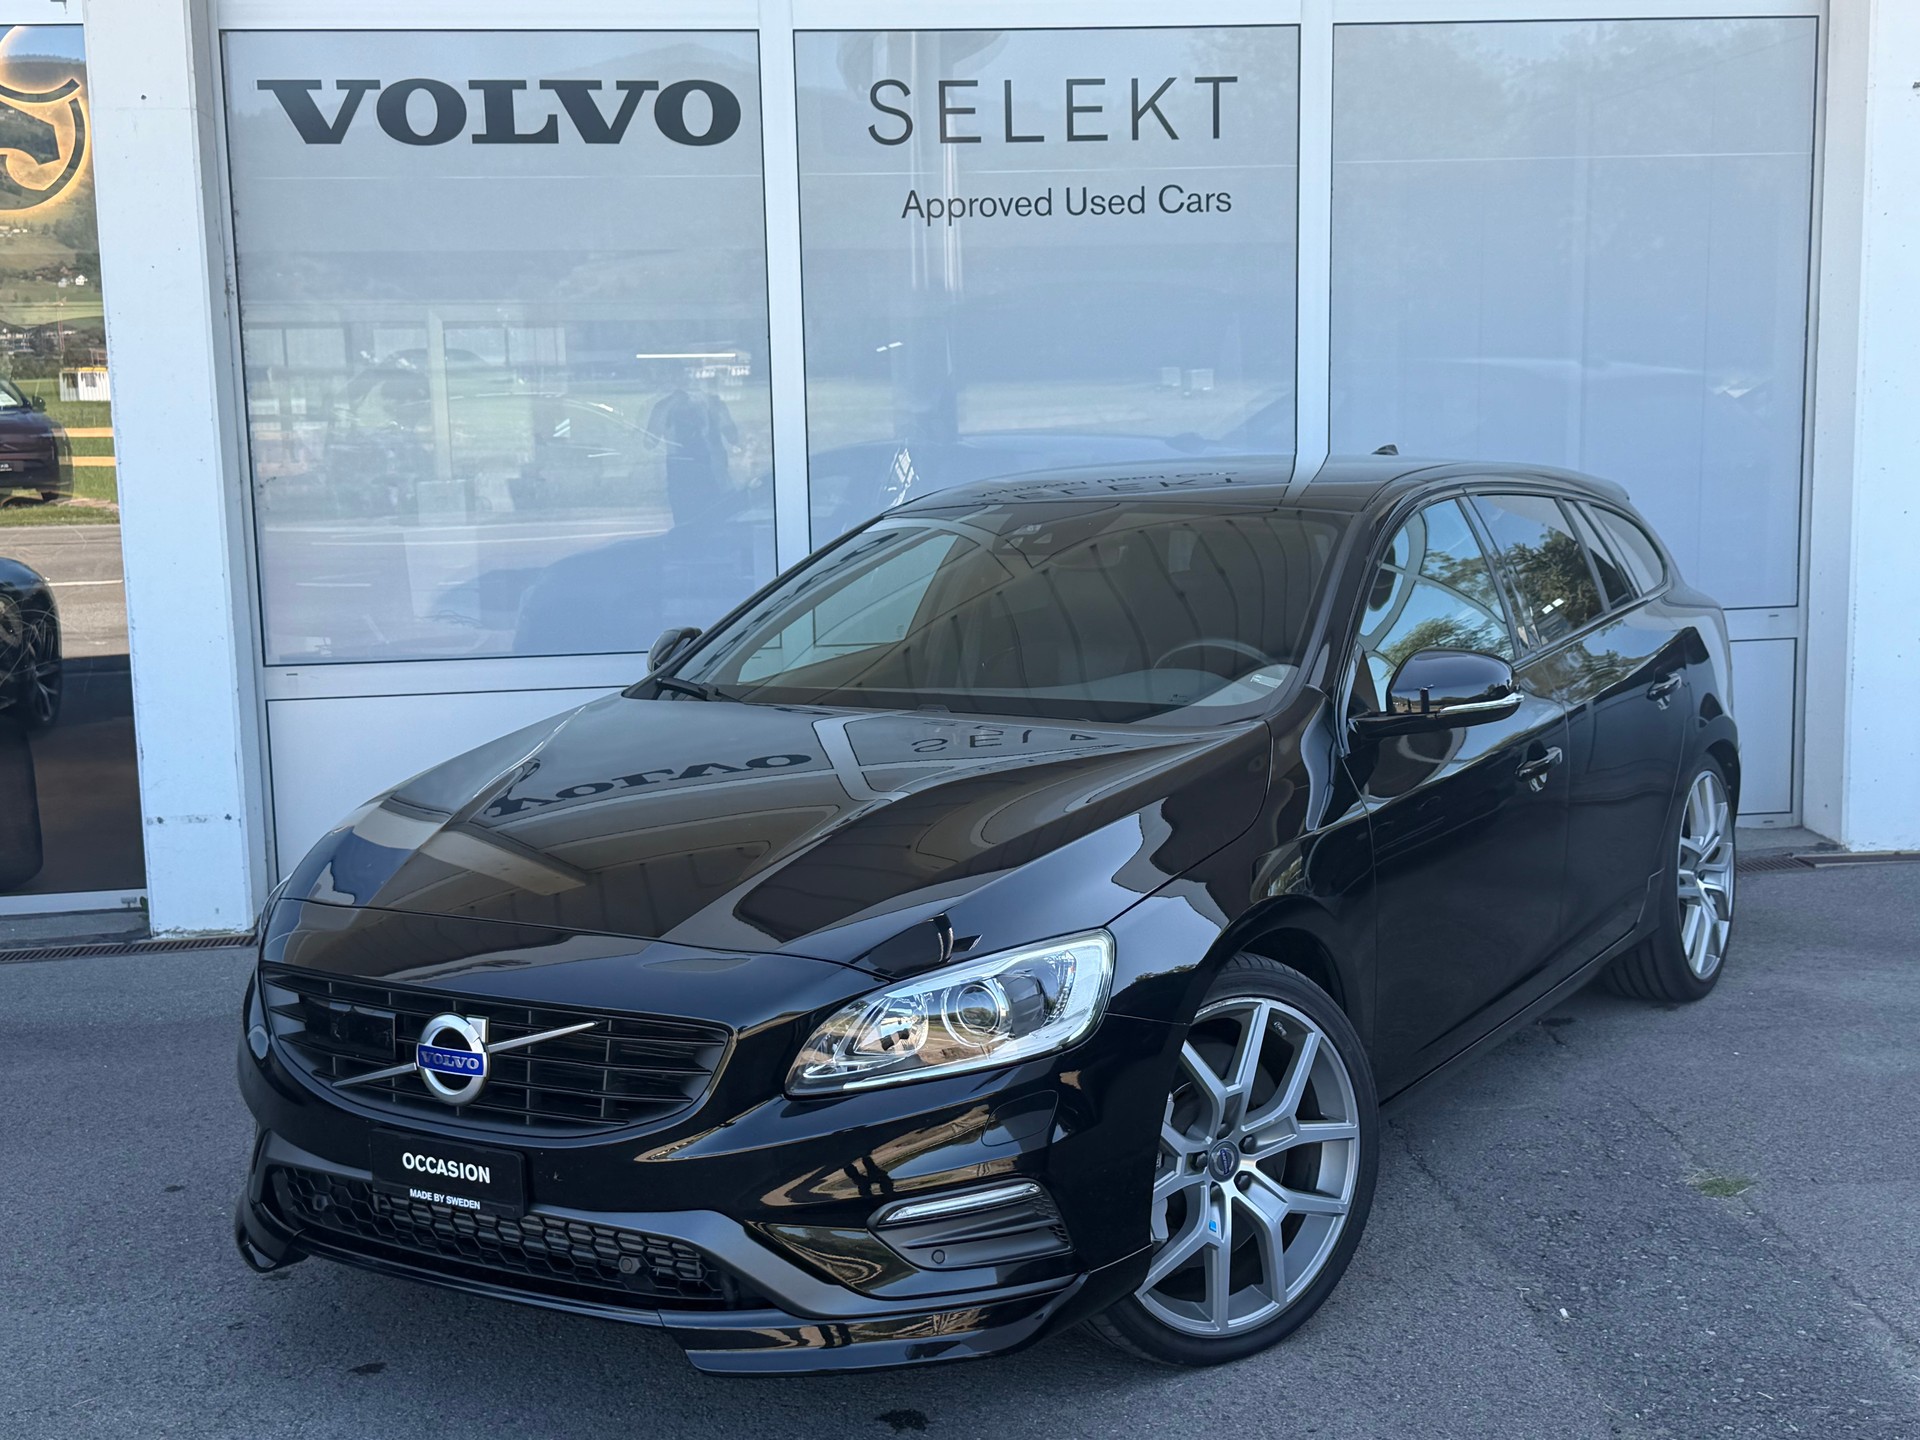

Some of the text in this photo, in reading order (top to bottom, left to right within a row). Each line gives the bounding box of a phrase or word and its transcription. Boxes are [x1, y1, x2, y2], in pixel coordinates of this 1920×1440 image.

[257, 77, 742, 147] VOLVO
[868, 76, 1238, 146] SELEKT
[901, 183, 1232, 226] Approved Used Cars
[420, 1050, 480, 1071] VOLVO
[402, 1151, 491, 1184] OCCASION
[409, 1188, 481, 1210] MADE BY SWEDEN
